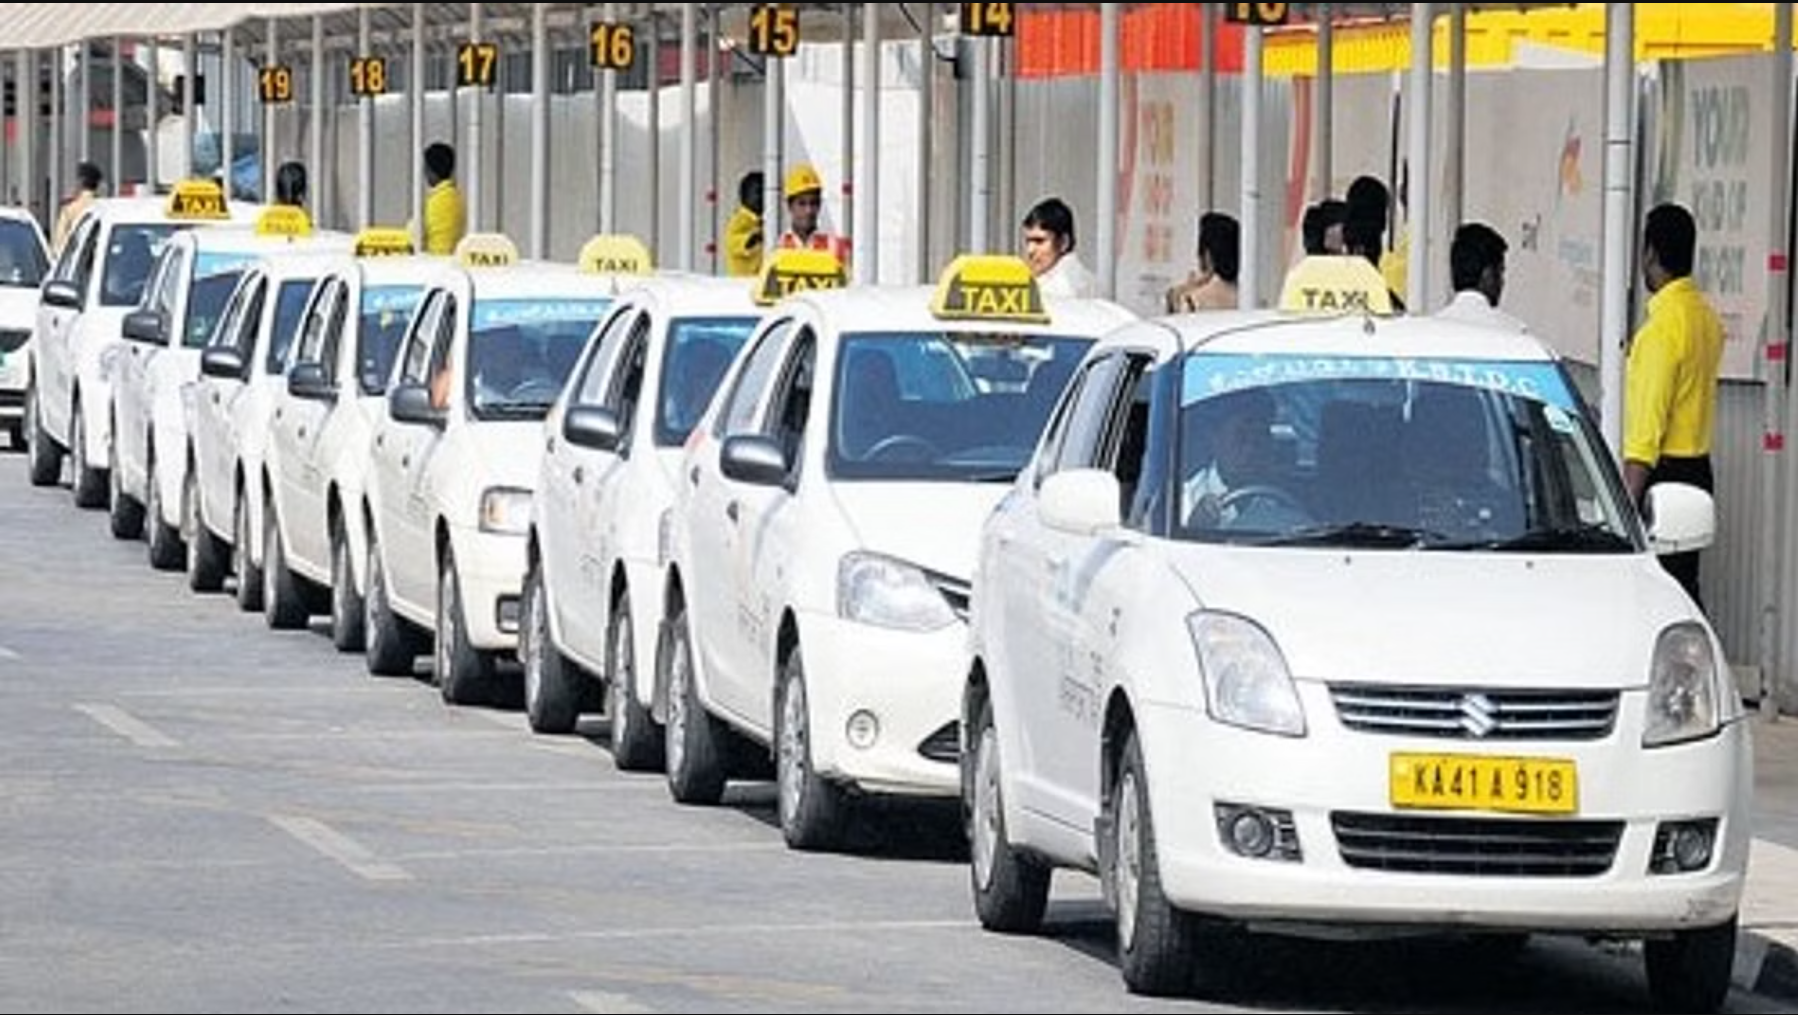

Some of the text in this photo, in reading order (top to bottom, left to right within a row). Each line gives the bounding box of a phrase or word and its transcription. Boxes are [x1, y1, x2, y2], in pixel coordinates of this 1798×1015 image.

[751, 7, 796, 52] 15
[592, 26, 632, 68] 16
[351, 60, 384, 92] 18
[460, 46, 495, 82] 17
[262, 70, 290, 99] 19
[469, 252, 509, 266] TAXI
[595, 258, 638, 273] TAXI
[777, 276, 836, 294] TAXI
[1302, 287, 1369, 309] TAXI
[961, 287, 1031, 314] TAXI
[1414, 763, 1562, 802] KA41 A 918
